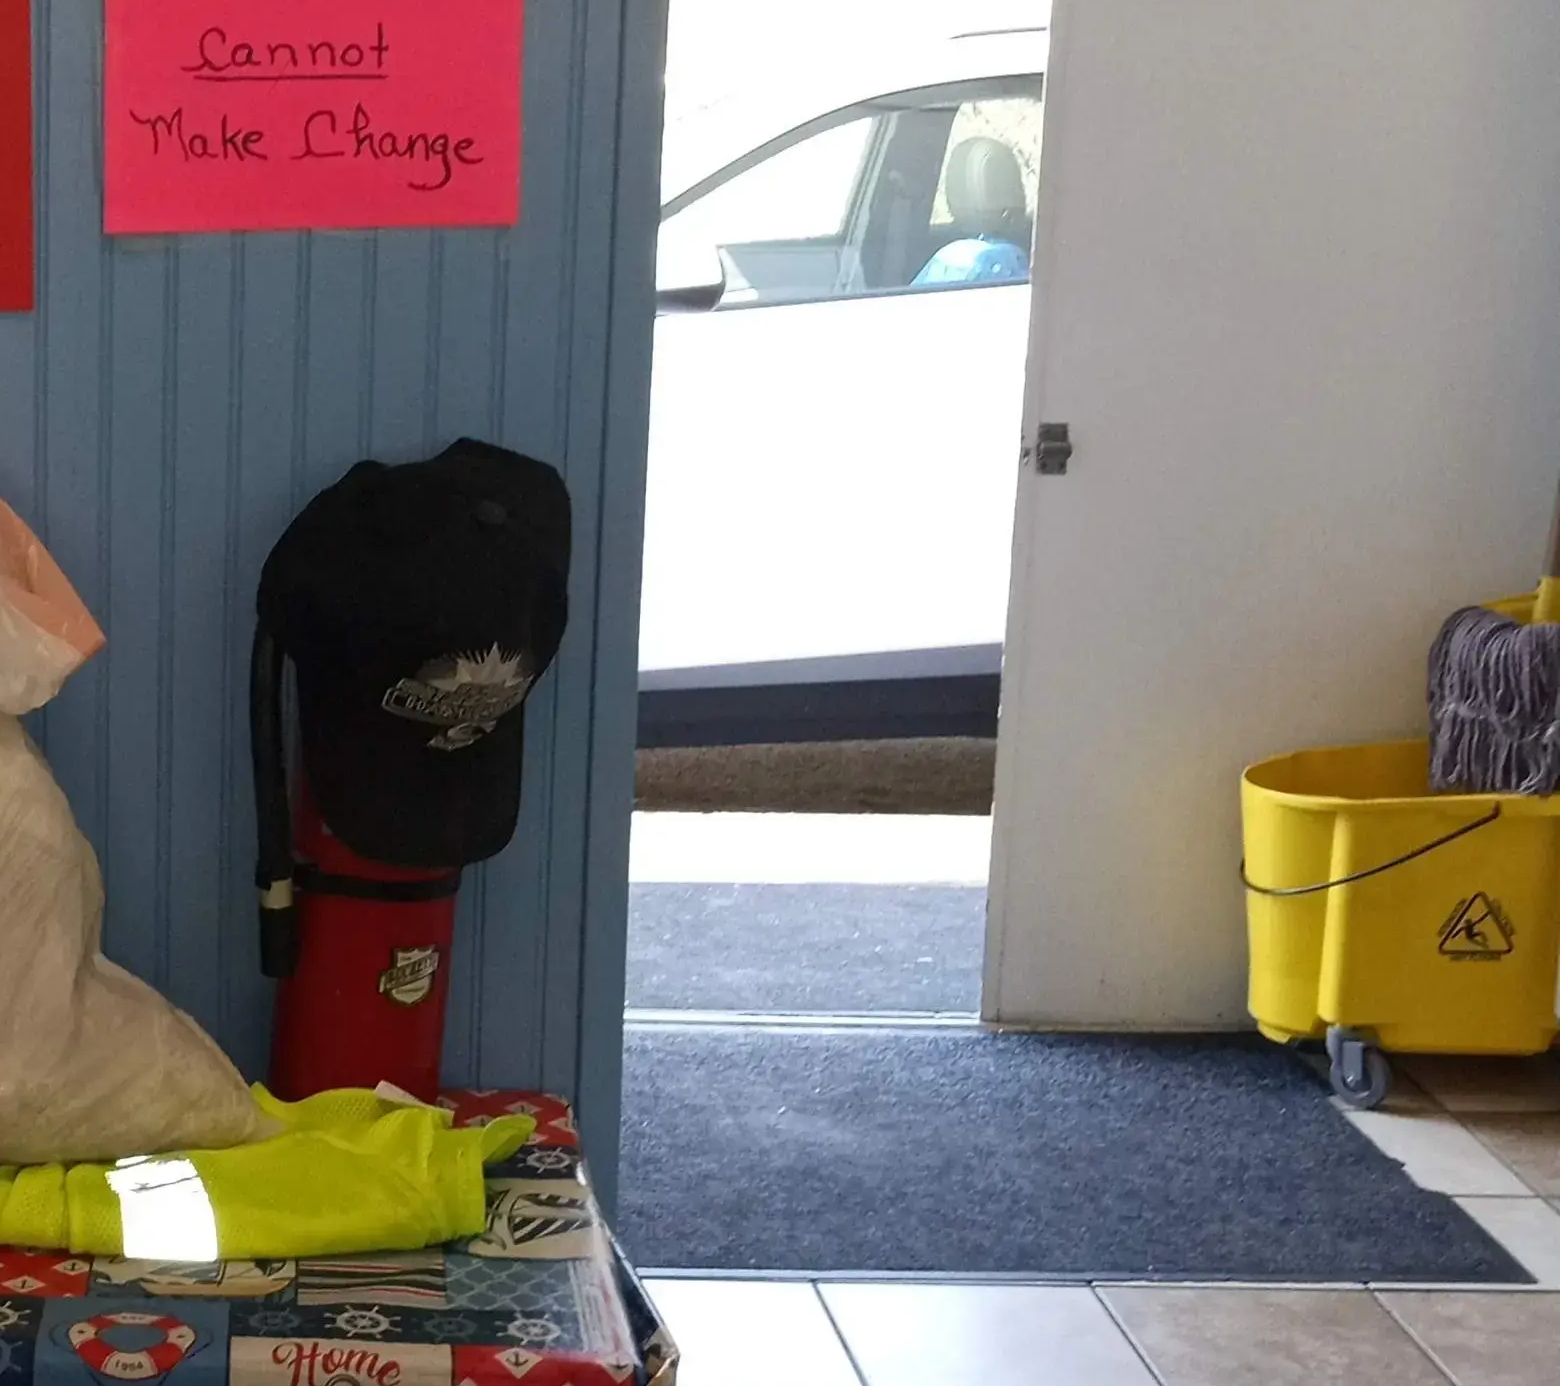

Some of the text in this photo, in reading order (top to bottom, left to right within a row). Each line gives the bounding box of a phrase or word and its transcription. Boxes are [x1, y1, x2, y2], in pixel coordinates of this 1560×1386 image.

[181, 21, 389, 75] Cannot
[129, 102, 484, 190] Make Change
